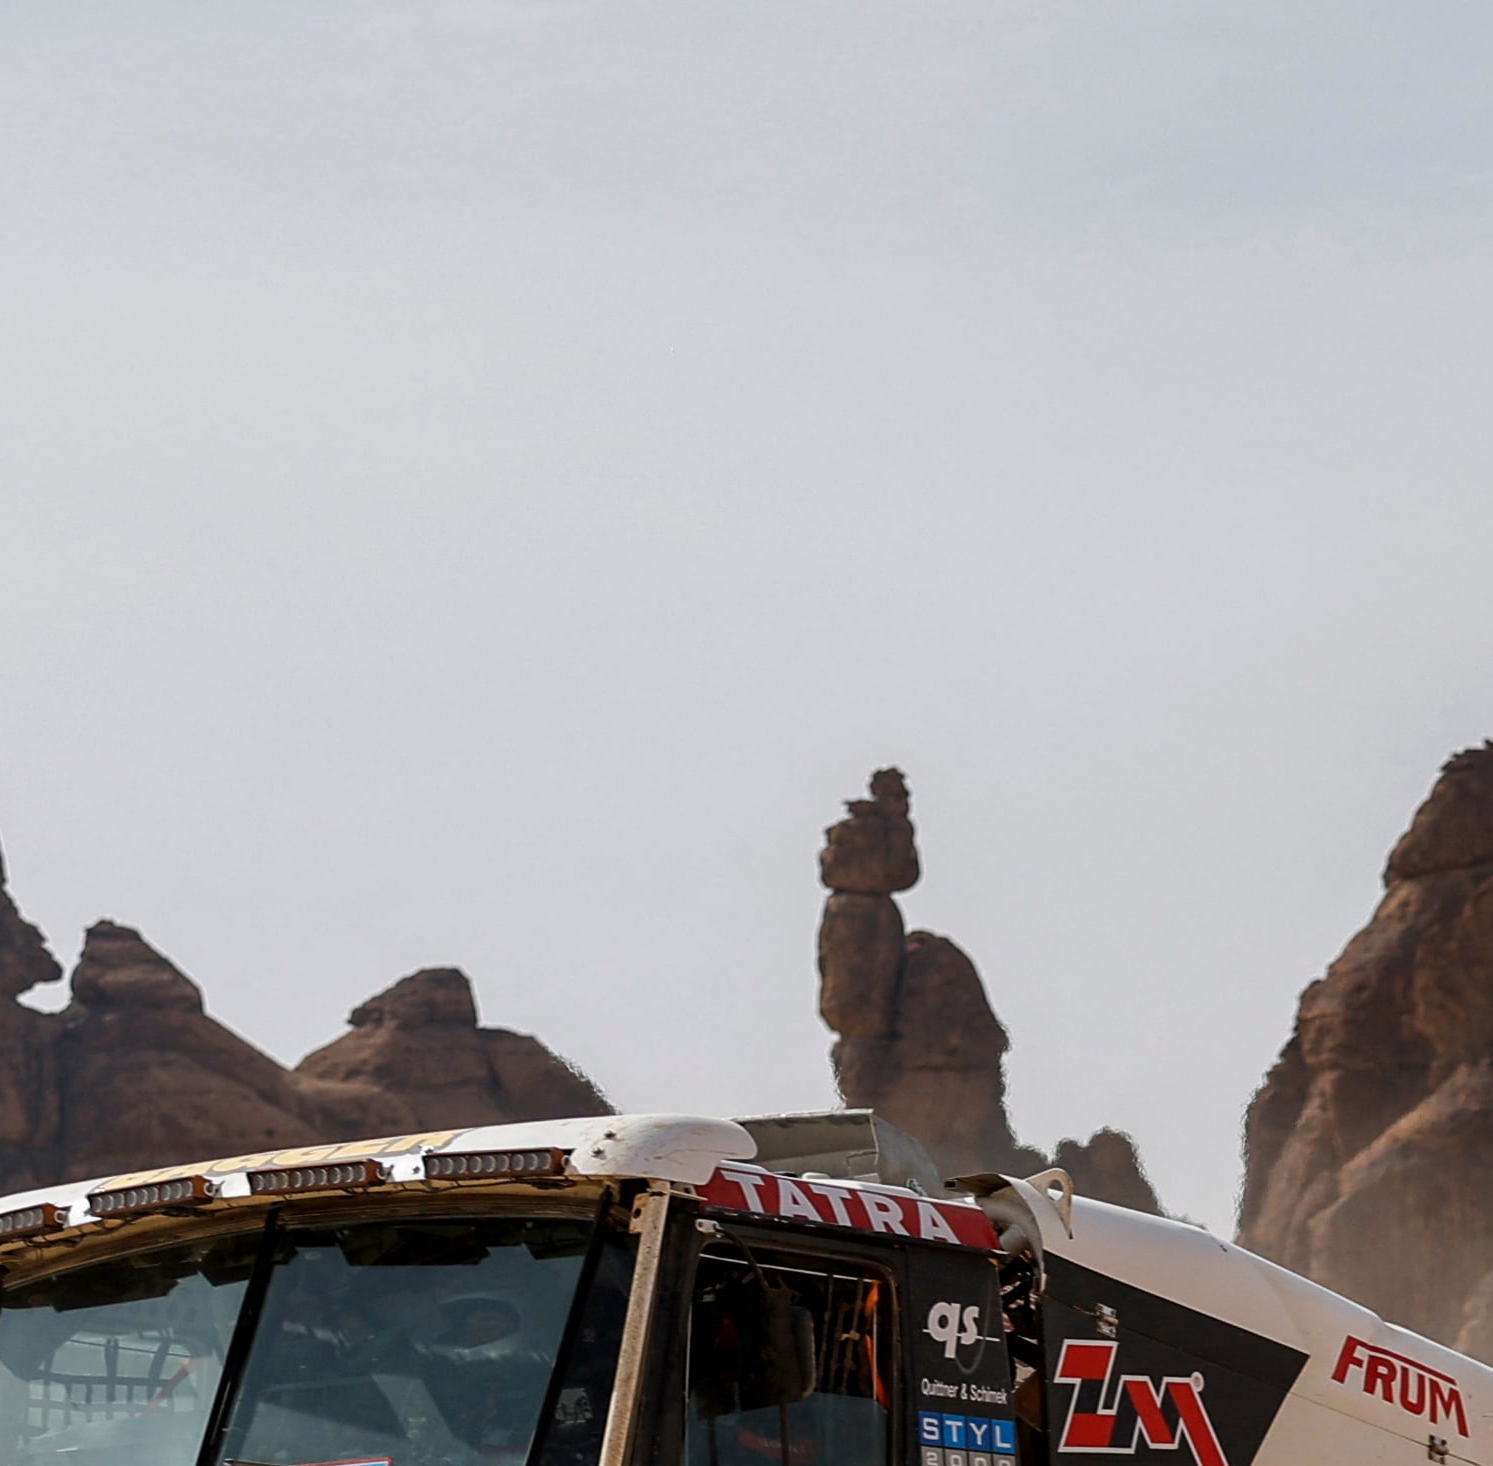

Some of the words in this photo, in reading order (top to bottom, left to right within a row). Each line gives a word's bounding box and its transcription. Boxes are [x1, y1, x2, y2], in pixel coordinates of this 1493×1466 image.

[719, 1169, 961, 1245] TATRA
[1331, 1335, 1470, 1438] FRUM
[922, 1417, 1013, 1449] STYL
